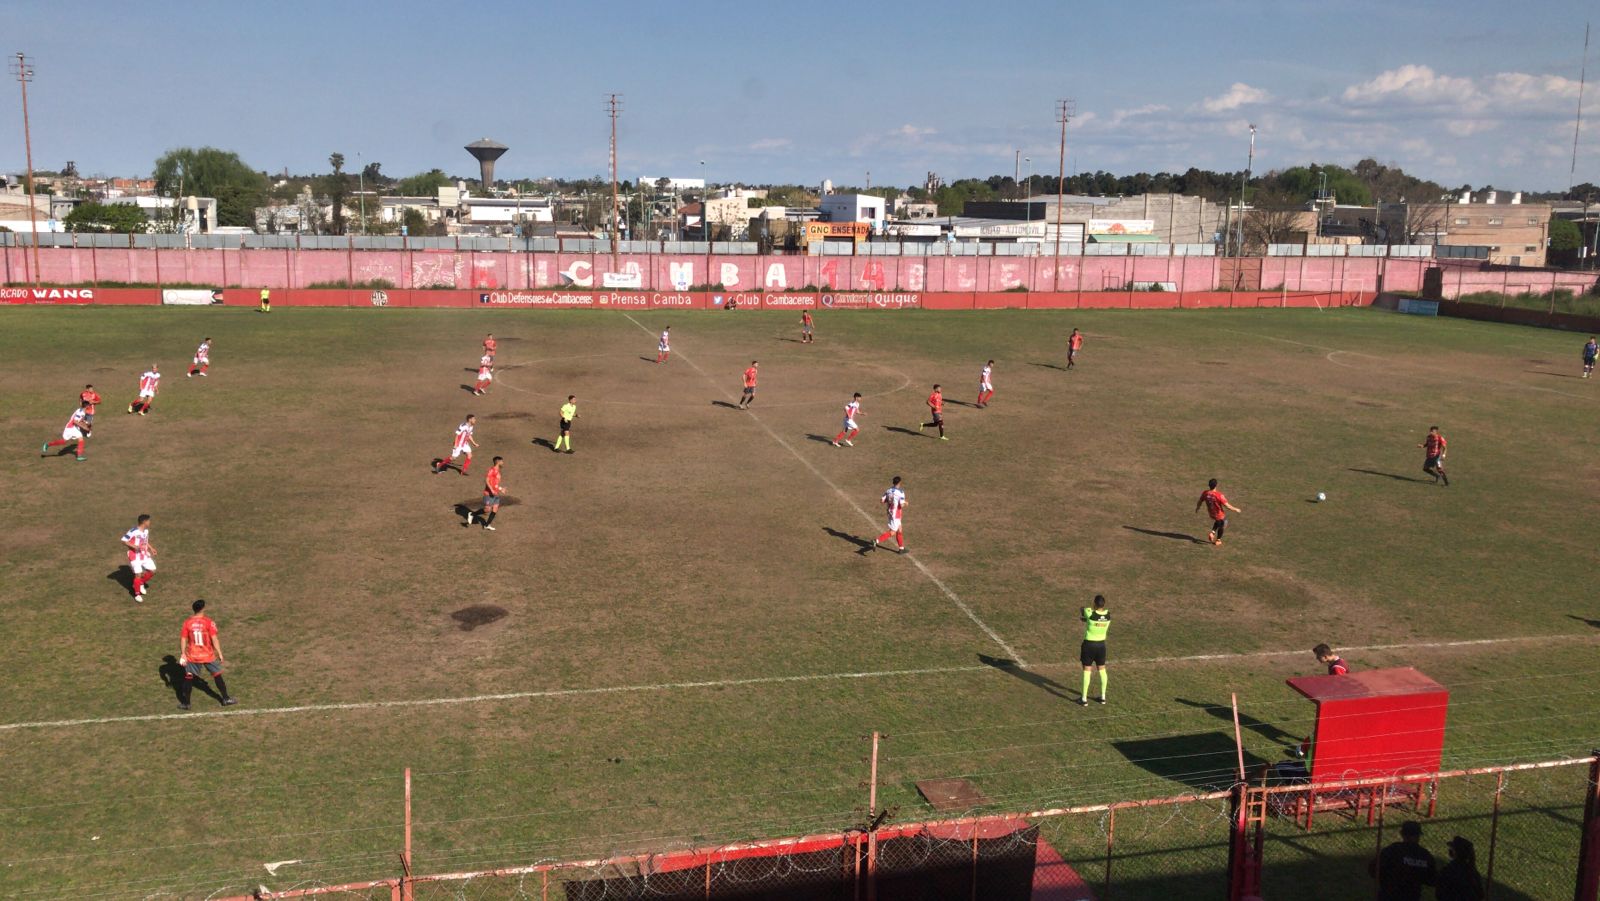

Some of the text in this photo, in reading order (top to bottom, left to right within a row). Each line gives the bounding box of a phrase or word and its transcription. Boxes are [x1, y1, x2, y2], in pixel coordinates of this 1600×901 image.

[810, 226, 829, 234] GNC
[32, 289, 93, 298] WANG
[490, 292, 507, 303] Club
[508, 292, 545, 304] Defensores
[552, 292, 593, 304] Cambaceres
[611, 293, 691, 304] Prensa Camba
[736, 294, 814, 305] Club Cambaceres
[875, 293, 917, 307] Quique
[193, 630, 204, 646] 11
